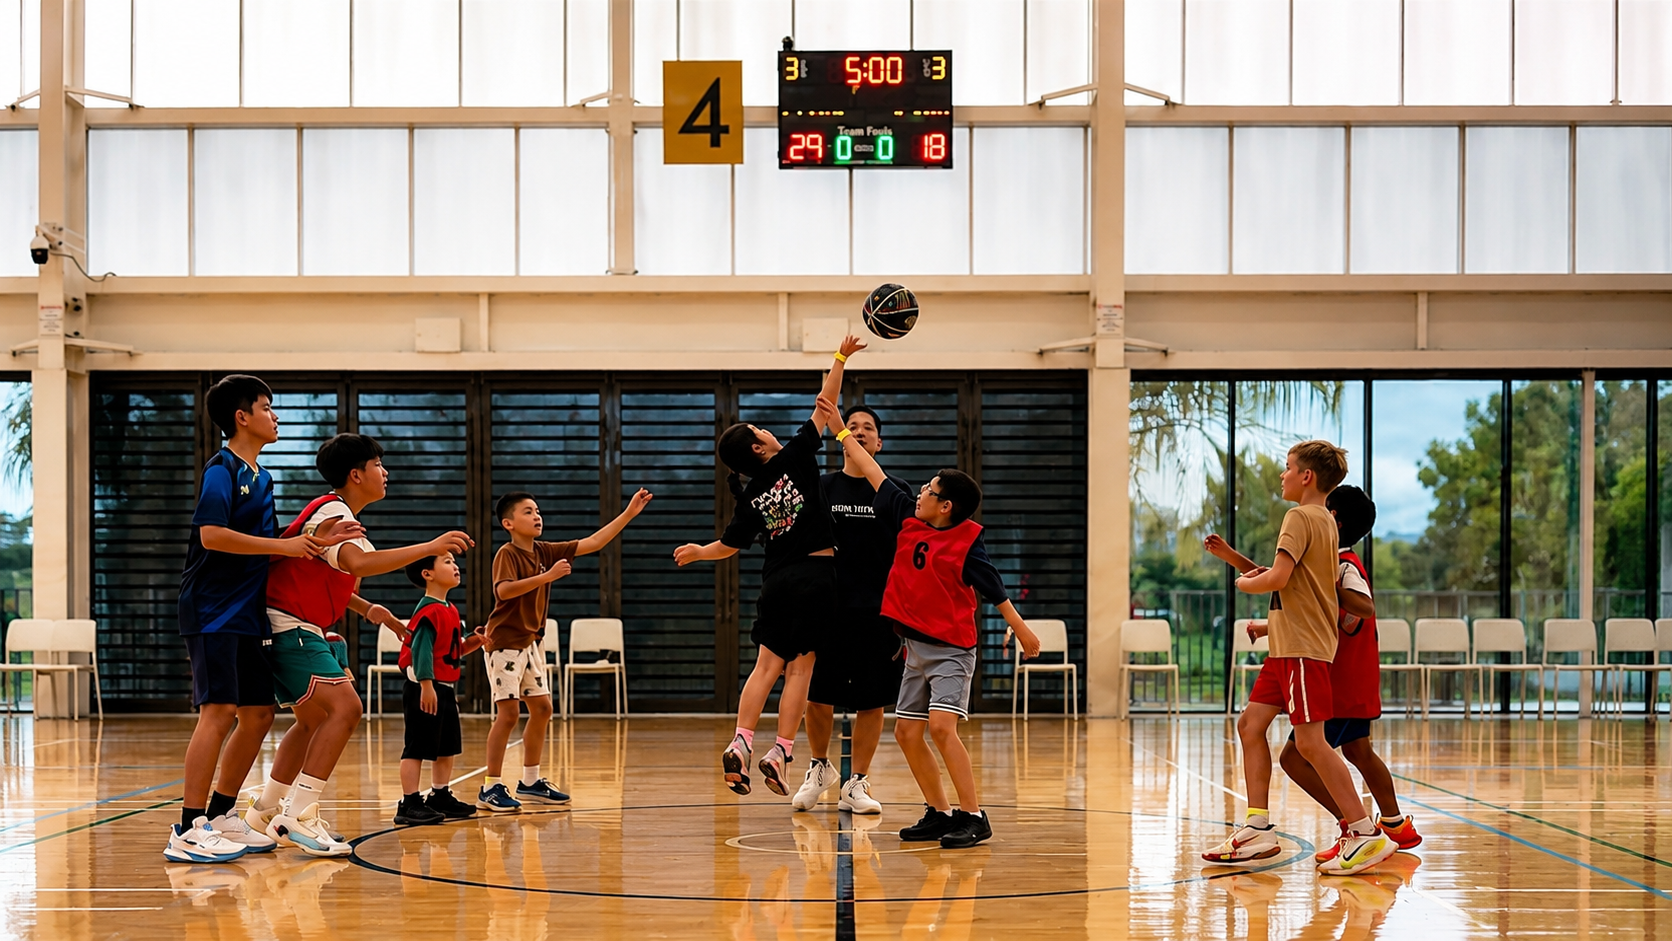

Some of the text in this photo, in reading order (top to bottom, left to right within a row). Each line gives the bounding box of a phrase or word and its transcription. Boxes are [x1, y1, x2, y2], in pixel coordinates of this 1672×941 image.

[785, 56, 799, 81] 3
[845, 56, 903, 84] 5:00
[931, 56, 946, 80] 3
[678, 76, 730, 148] 4
[789, 133, 823, 160] 29
[836, 135, 852, 160] 0
[878, 135, 893, 160] 0
[923, 133, 946, 160] 18
[912, 541, 930, 571] 6
